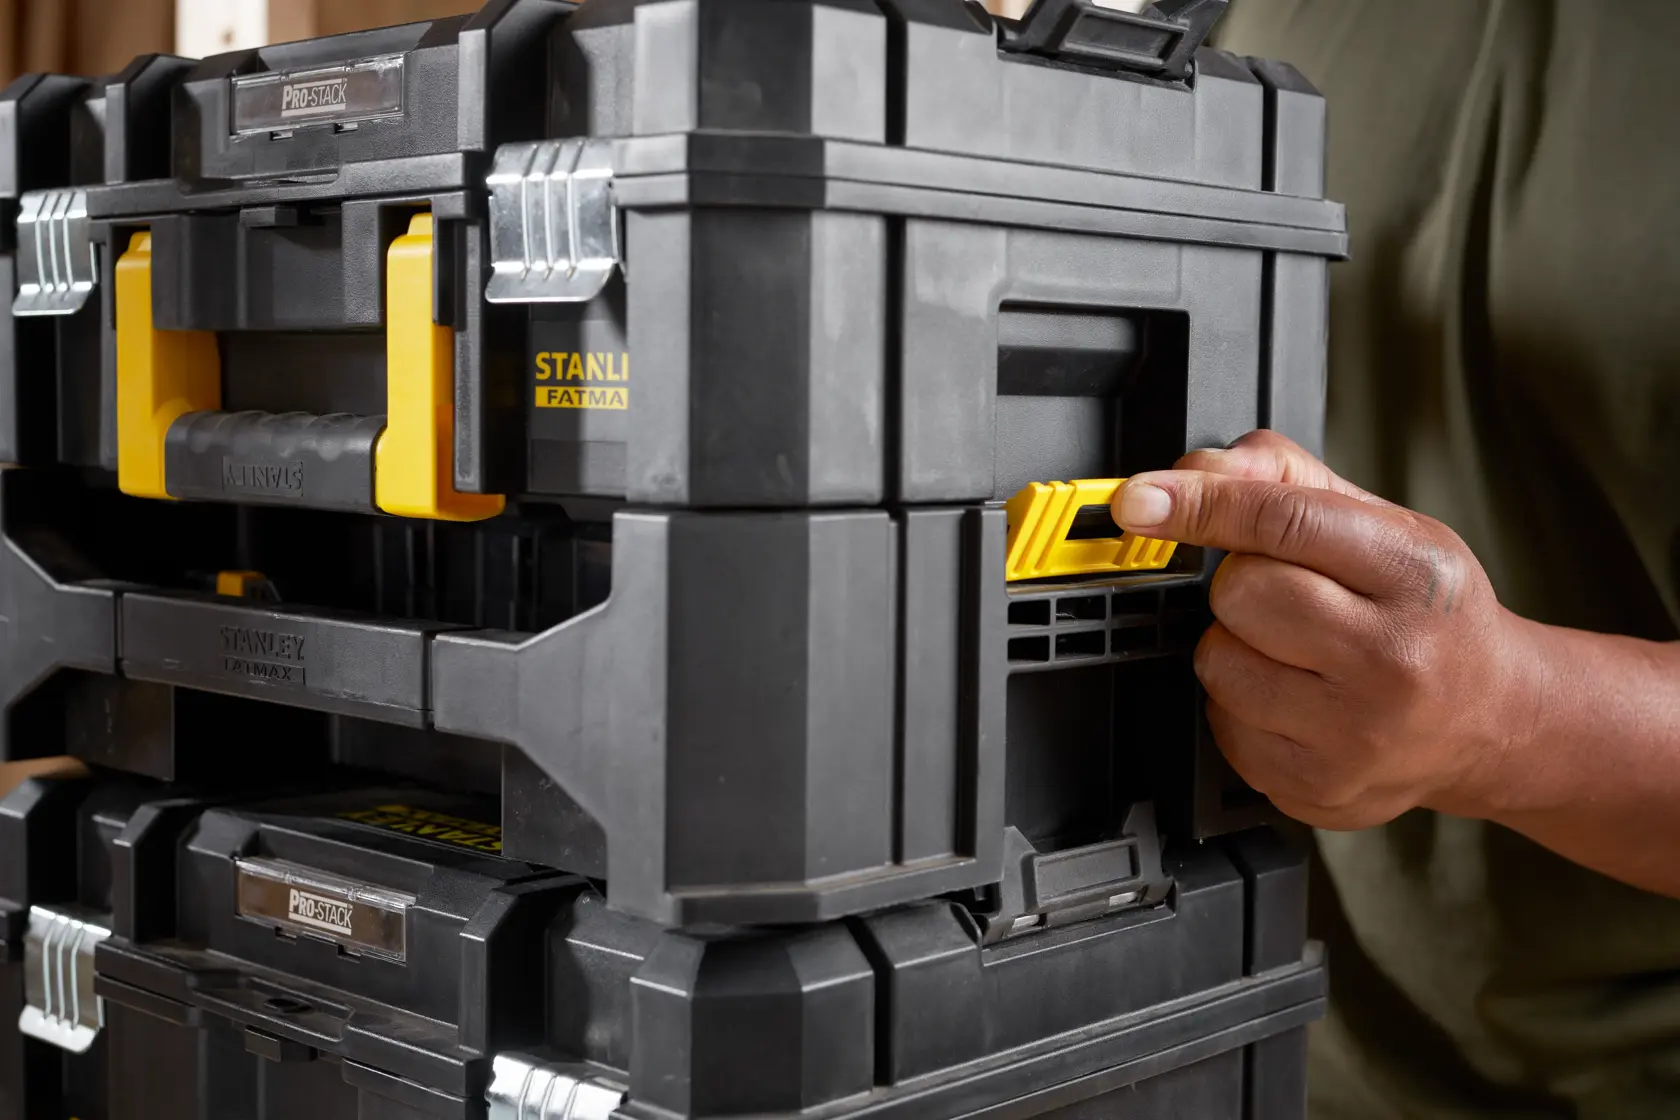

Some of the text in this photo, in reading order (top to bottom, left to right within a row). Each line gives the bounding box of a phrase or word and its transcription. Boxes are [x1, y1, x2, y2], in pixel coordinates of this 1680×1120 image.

[281, 83, 348, 110] PRO-STACK
[220, 626, 305, 661] STANLEY
[289, 888, 353, 928] PRO-STACK
